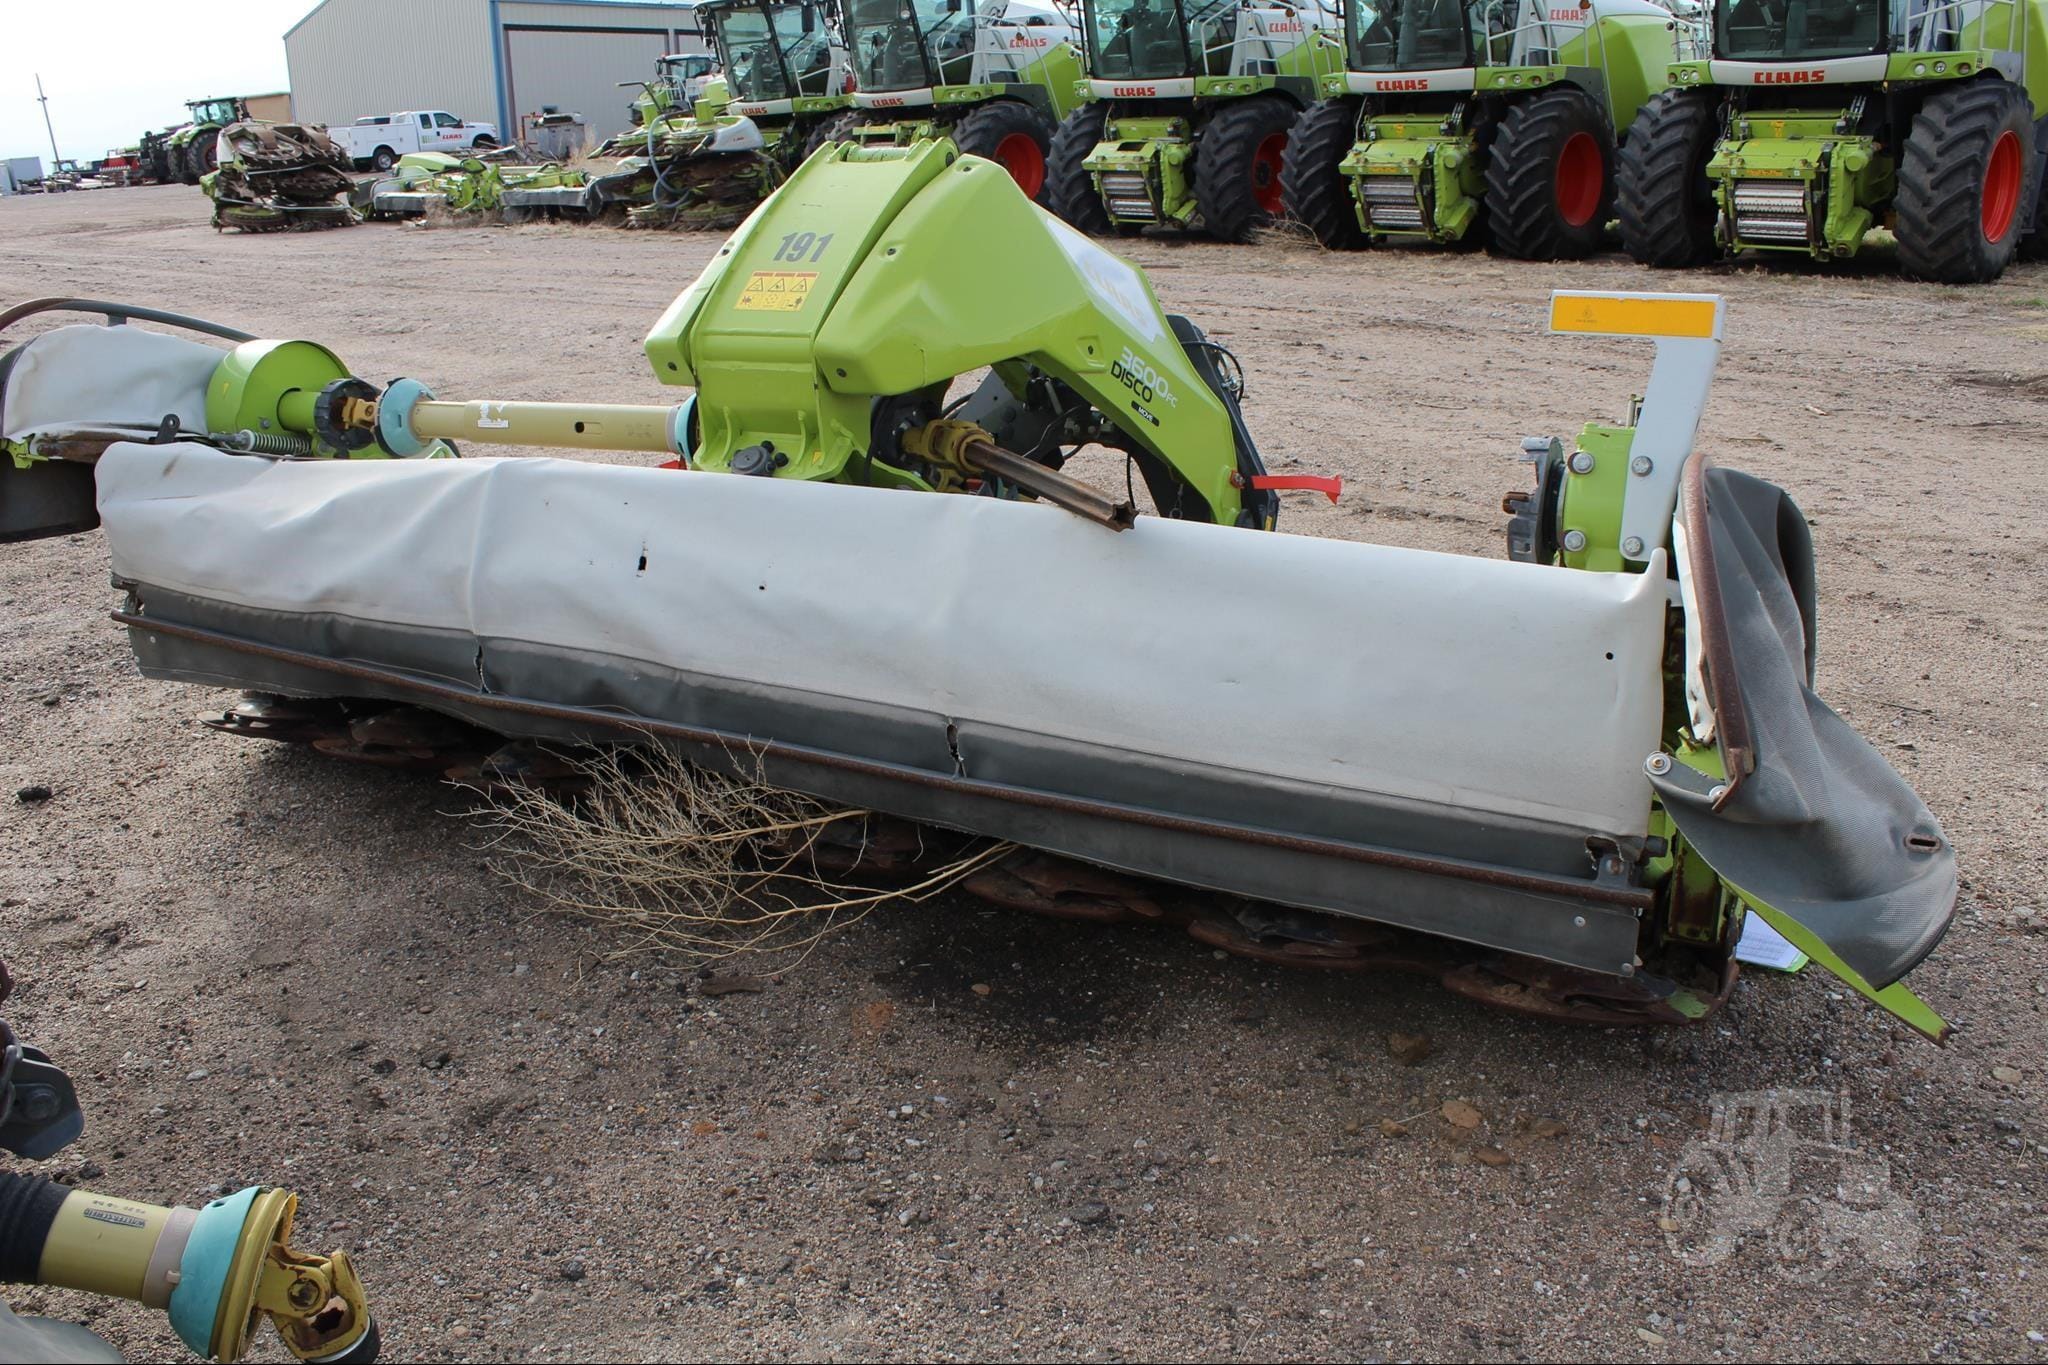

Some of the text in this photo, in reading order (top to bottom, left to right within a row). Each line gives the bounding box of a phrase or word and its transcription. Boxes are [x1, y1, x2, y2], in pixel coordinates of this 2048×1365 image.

[1754, 70, 1825, 84] CLAAS
[1114, 87, 1156, 96] CLAAS
[1376, 80, 1428, 91] CLAAS
[871, 97, 904, 107] CLAAS
[741, 107, 768, 115] CLAAS
[773, 232, 834, 263] 191
[1111, 360, 1153, 403] DISCO
[1138, 406, 1154, 422] MOVE
